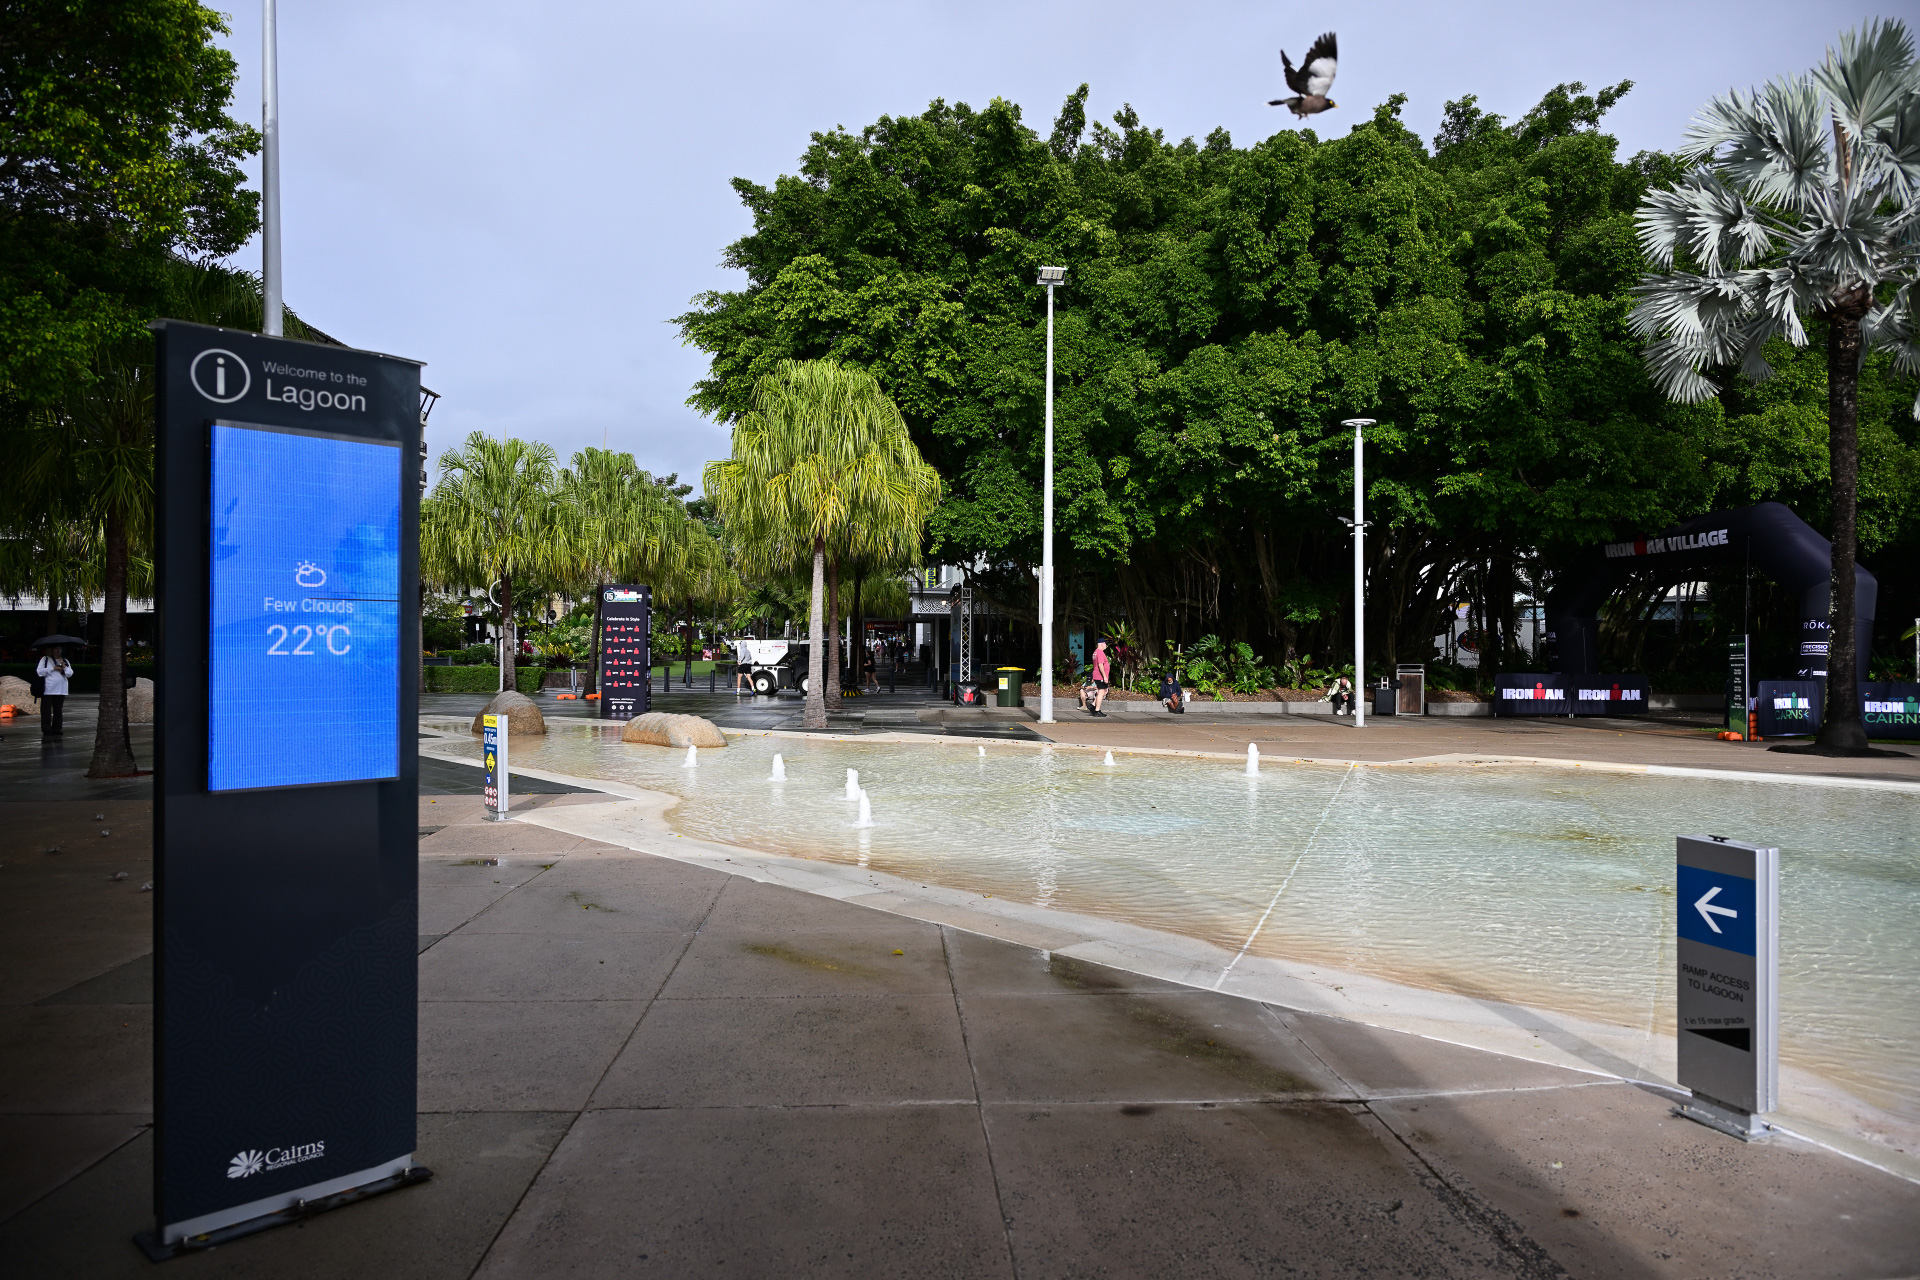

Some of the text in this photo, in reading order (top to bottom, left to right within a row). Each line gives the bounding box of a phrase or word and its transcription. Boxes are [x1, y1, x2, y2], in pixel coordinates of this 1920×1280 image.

[262, 360, 367, 387] Welcome to the
[266, 378, 367, 412] Lagoon
[1604, 528, 1729, 558] IRONMAN VILLAGE
[263, 597, 354, 613] Few Clouds
[266, 624, 351, 656] 22°C
[1502, 682, 1565, 700] IRONMAN
[1578, 683, 1641, 701] IRONMAN
[1864, 696, 1920, 714] IRONM
[1864, 713, 1920, 724] CAIRN
[1682, 964, 1750, 990] RAMP ACCESS
[1688, 978, 1744, 1003] TO LAGOON
[1723, 1016, 1745, 1026] grade
[265, 1140, 325, 1165] Cairns
[266, 1152, 324, 1171] REGIONAL COUNCIL
